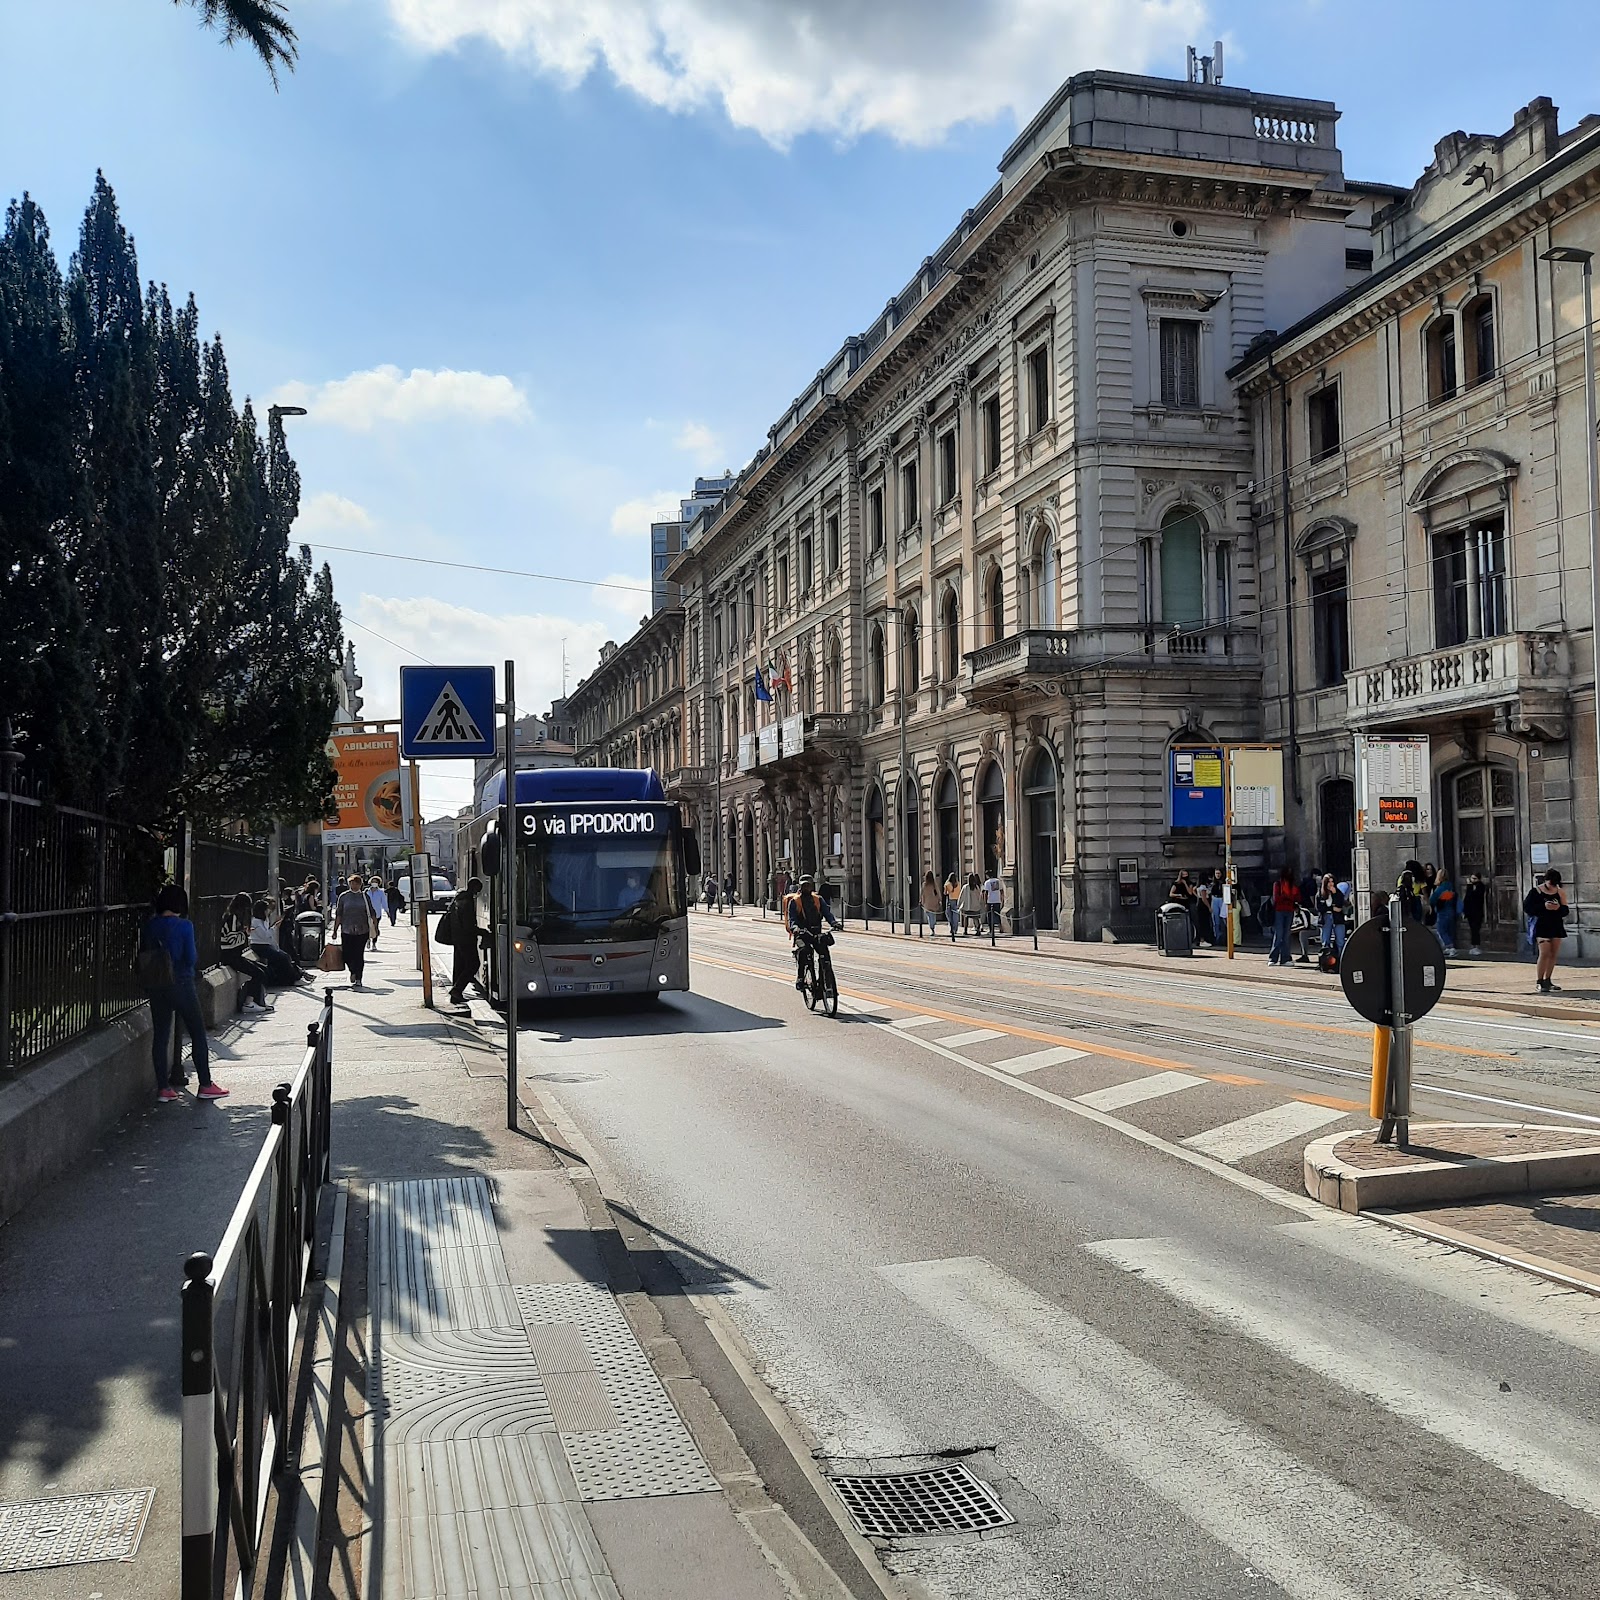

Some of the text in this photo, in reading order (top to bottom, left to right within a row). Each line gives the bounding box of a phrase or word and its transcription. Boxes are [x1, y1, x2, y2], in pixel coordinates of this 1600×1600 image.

[343, 741, 394, 750] ABILMENTE
[1380, 799, 1414, 809] Busitalia
[1384, 811, 1408, 821] Veneto
[523, 812, 655, 835] 9 via IPPODROMO
